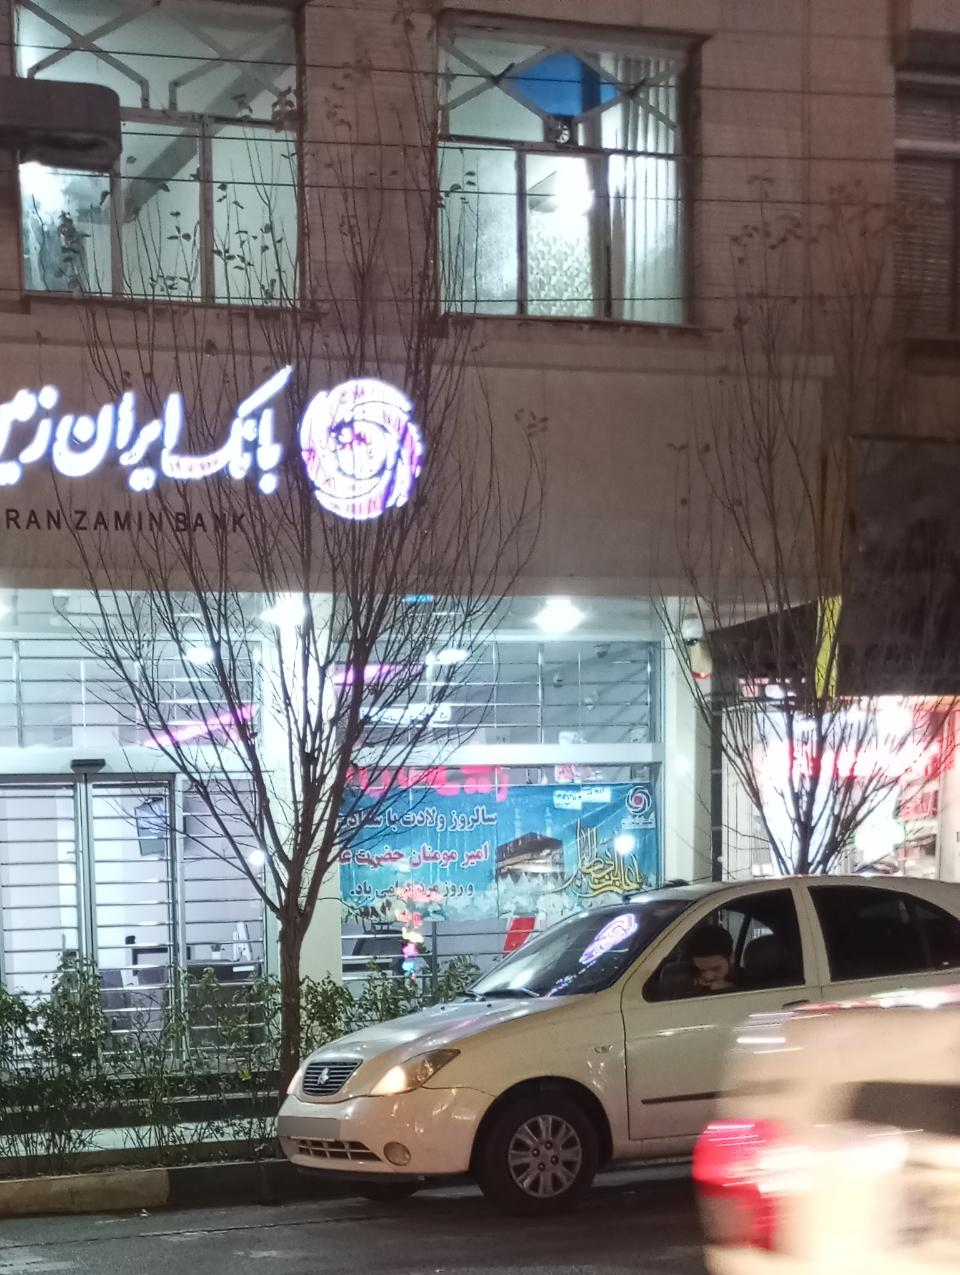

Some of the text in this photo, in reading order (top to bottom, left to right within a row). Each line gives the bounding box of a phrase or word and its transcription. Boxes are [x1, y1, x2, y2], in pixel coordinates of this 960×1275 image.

[53, 391, 184, 491] ایران
[73, 509, 164, 533] ZAMIN
[173, 511, 246, 534] BANK
[354, 846, 405, 868] حضرت
[460, 841, 489, 868] امیر
[443, 881, 464, 898] روز
